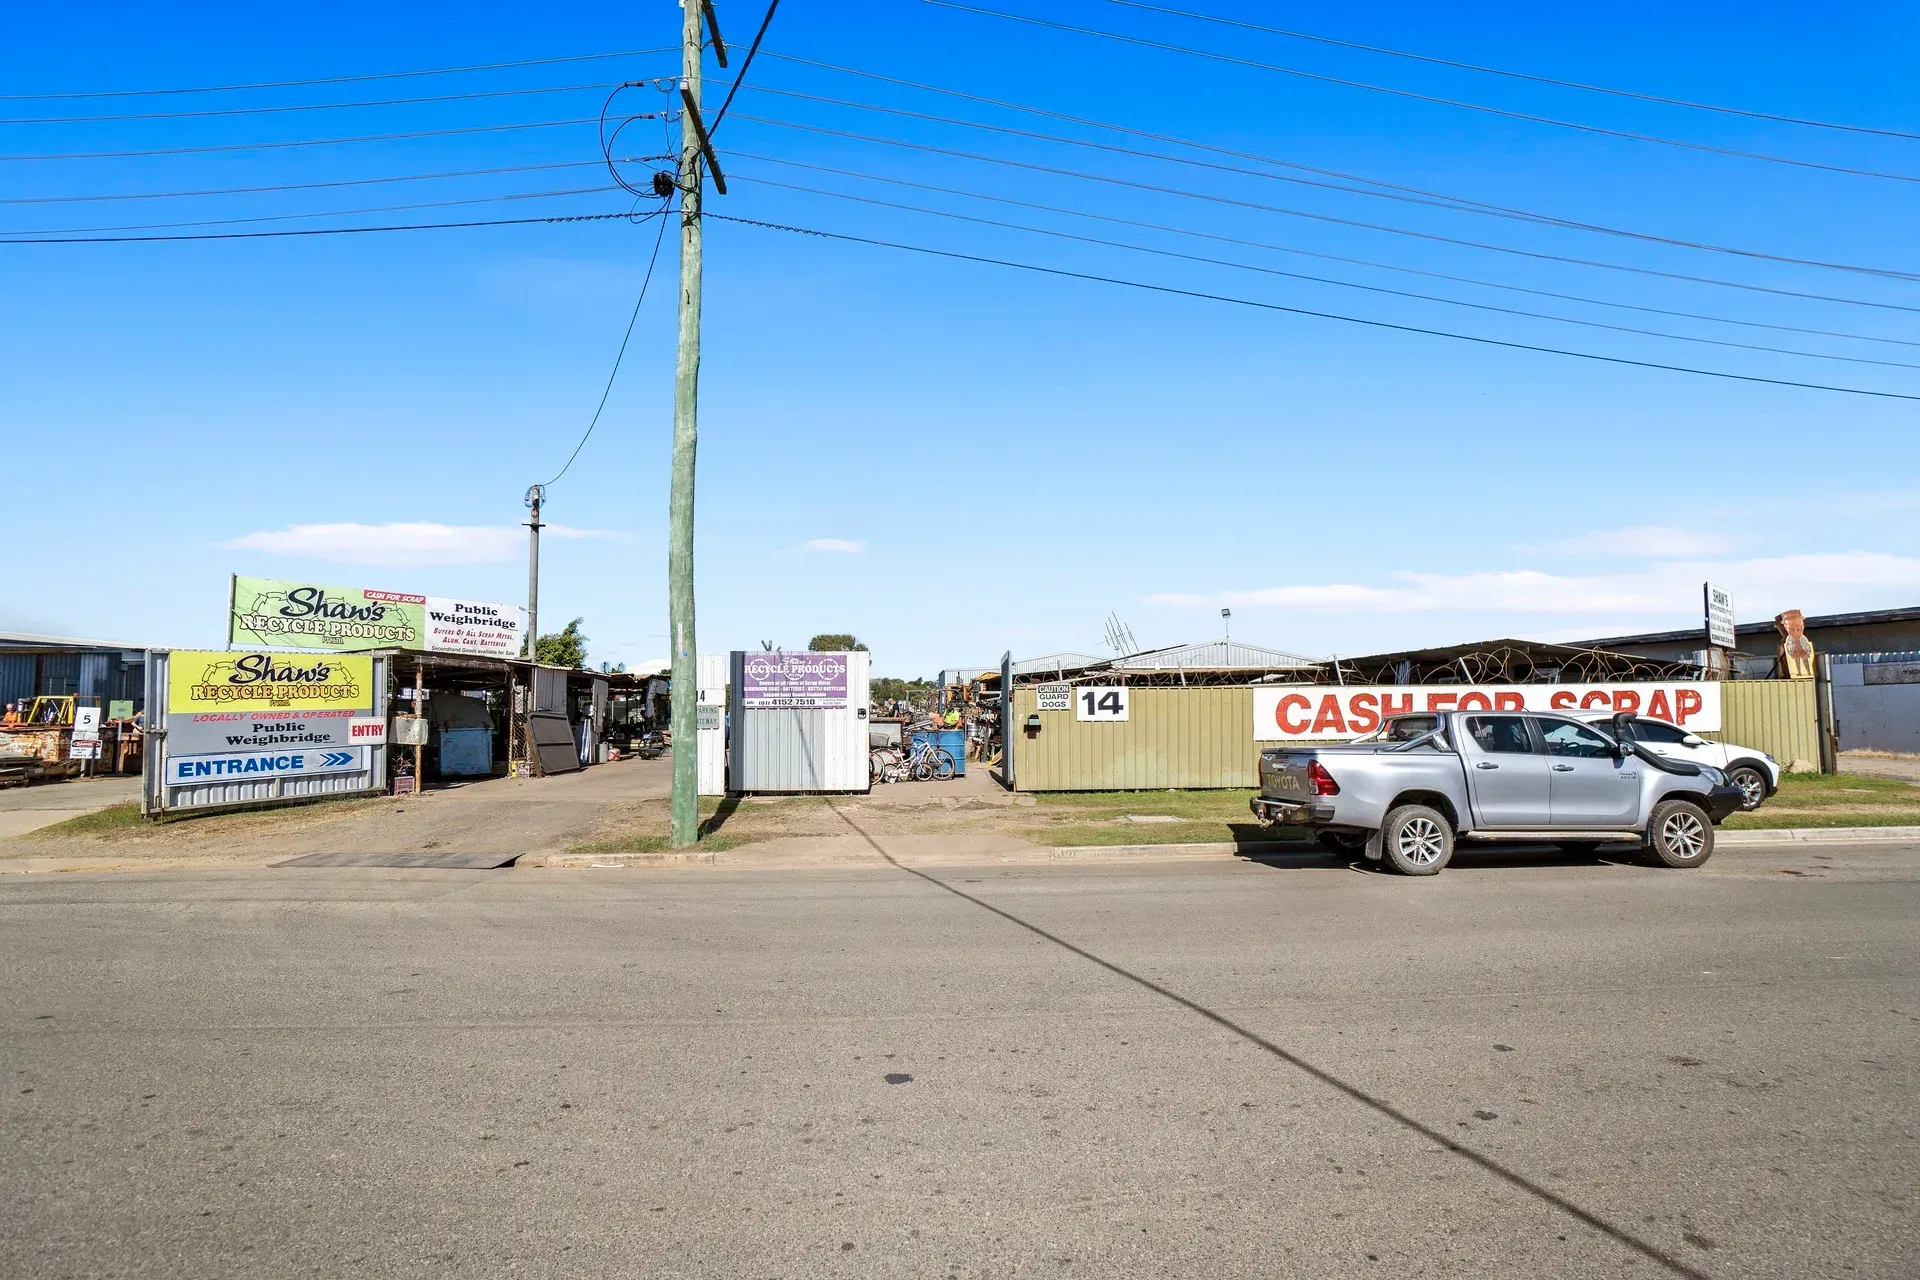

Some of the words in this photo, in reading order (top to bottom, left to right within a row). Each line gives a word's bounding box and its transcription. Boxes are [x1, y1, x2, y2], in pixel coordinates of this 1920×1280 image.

[280, 587, 386, 621] Shaw's
[386, 593, 401, 601] FOR
[402, 595, 425, 603] SCRAP
[455, 603, 498, 616] Public
[429, 611, 516, 629] Weighbridge
[239, 614, 326, 635] RECYCLE
[329, 622, 416, 641] PRODUCTS
[228, 654, 330, 684] Shaw's
[744, 664, 790, 674] RECYCLE
[791, 664, 846, 674] PRODUCTS
[191, 684, 274, 700] RECYCLE
[277, 684, 360, 700] PRODUCTS
[1039, 685, 1069, 693] CAUTION
[771, 698, 793, 706] 4152
[1082, 691, 1124, 716] 14
[83, 715, 91, 724] 5
[192, 713, 247, 723] LOCALLY
[251, 711, 291, 721] OWNED
[292, 711, 300, 719] &
[302, 710, 355, 720] OPERATED
[1275, 692, 1413, 735] CASH
[252, 722, 306, 733] Public
[352, 724, 384, 737] ENTRY
[226, 733, 331, 746] Weighbridge
[178, 755, 304, 778] ENTRANCE
[1267, 774, 1300, 791] TOYOTA
